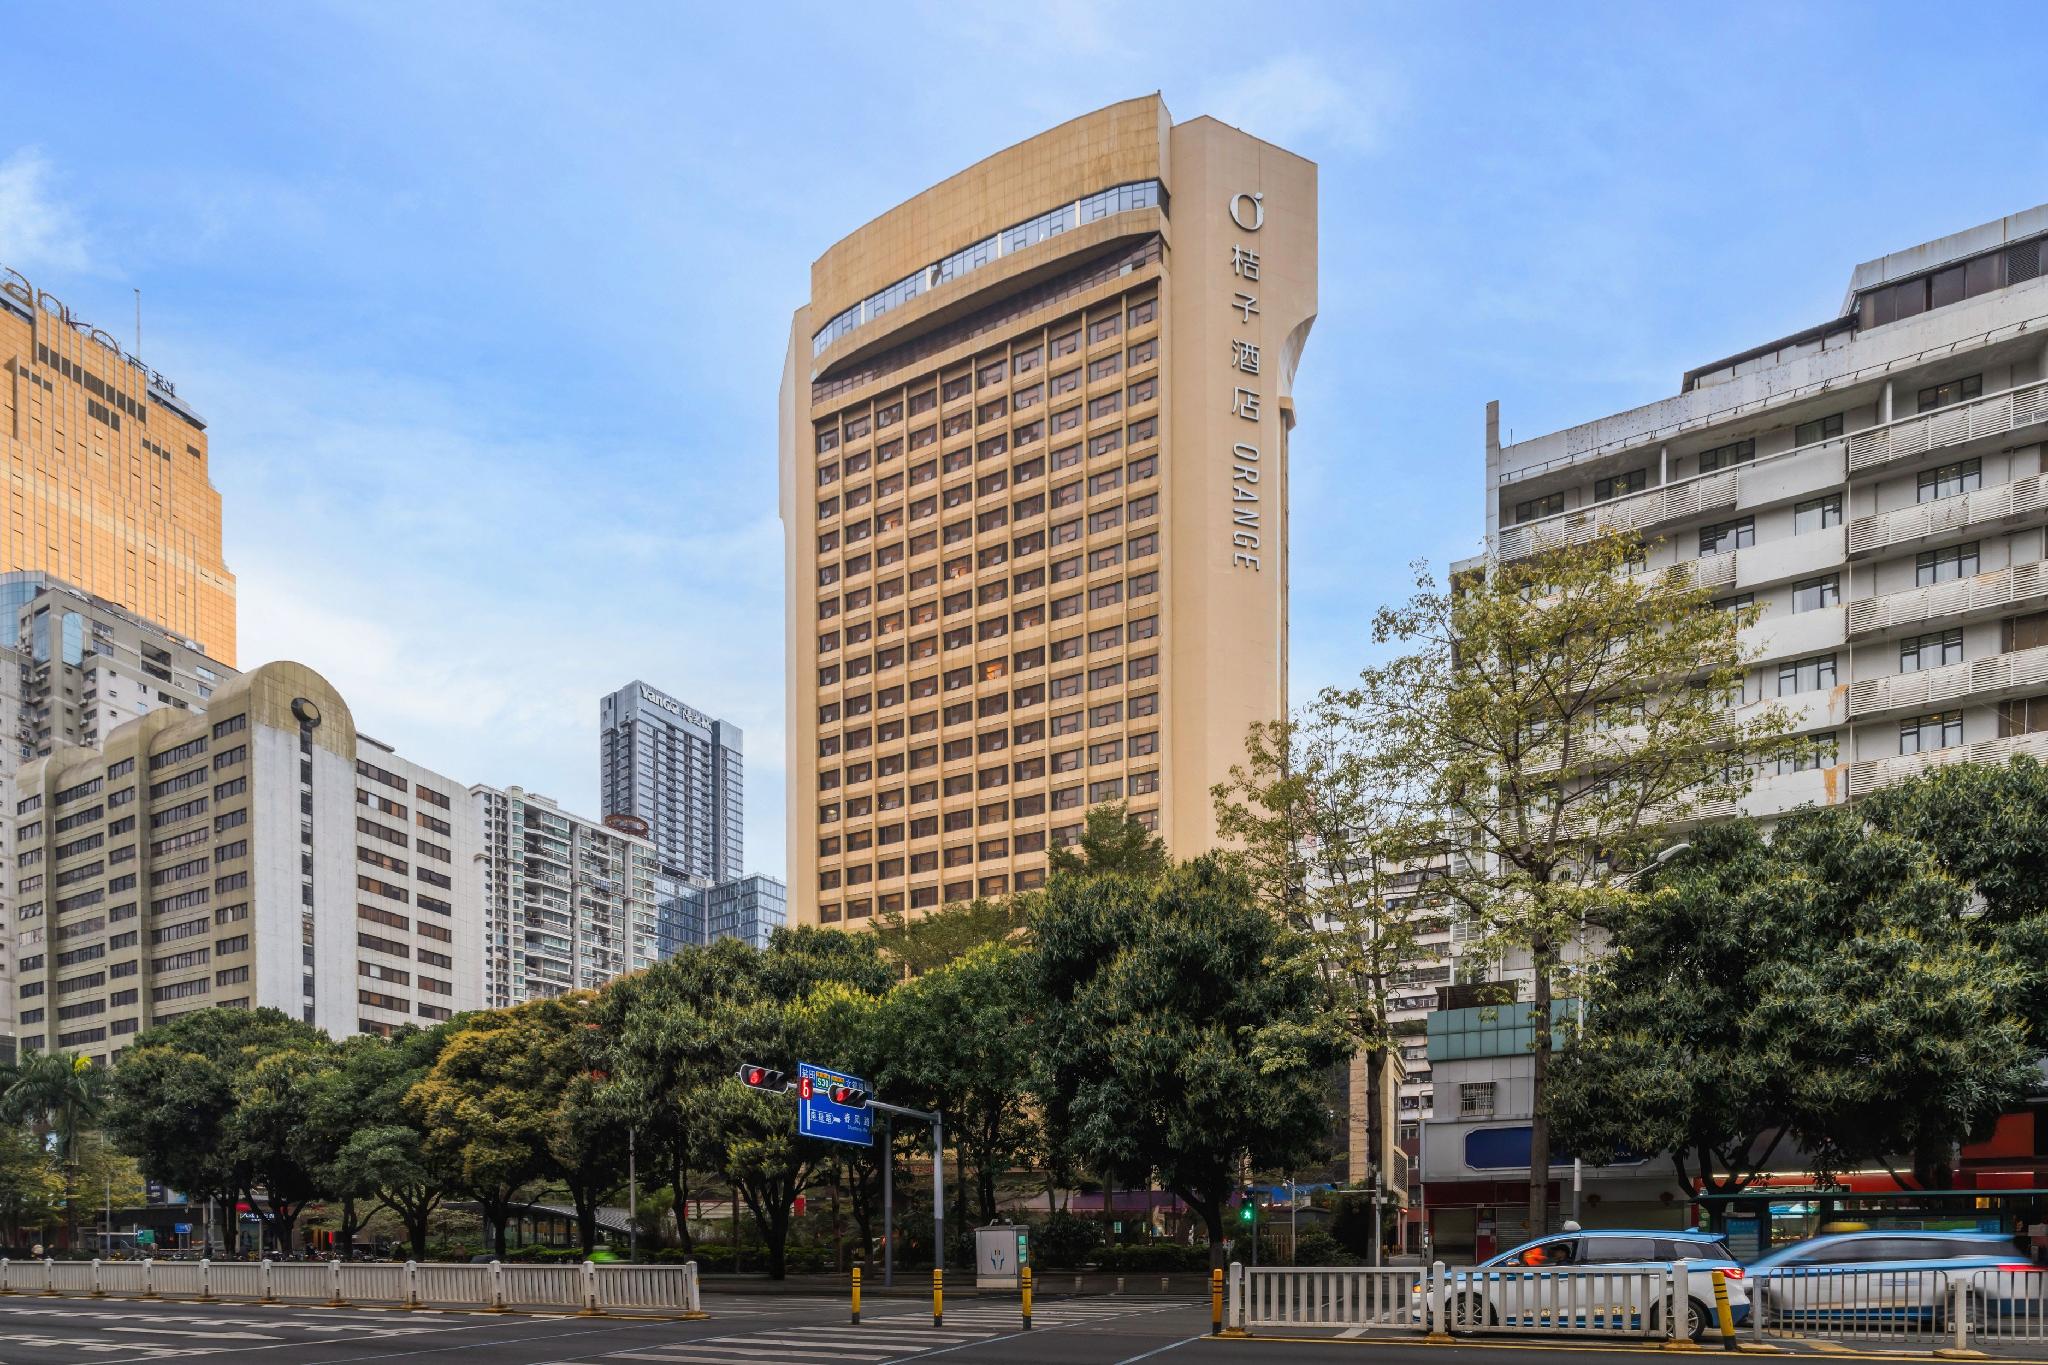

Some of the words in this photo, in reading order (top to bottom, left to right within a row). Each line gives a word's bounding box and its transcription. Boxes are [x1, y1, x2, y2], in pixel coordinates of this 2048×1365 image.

[1231, 243, 1260, 423] 桔子酒店
[1233, 442, 1260, 572] ORANGE
